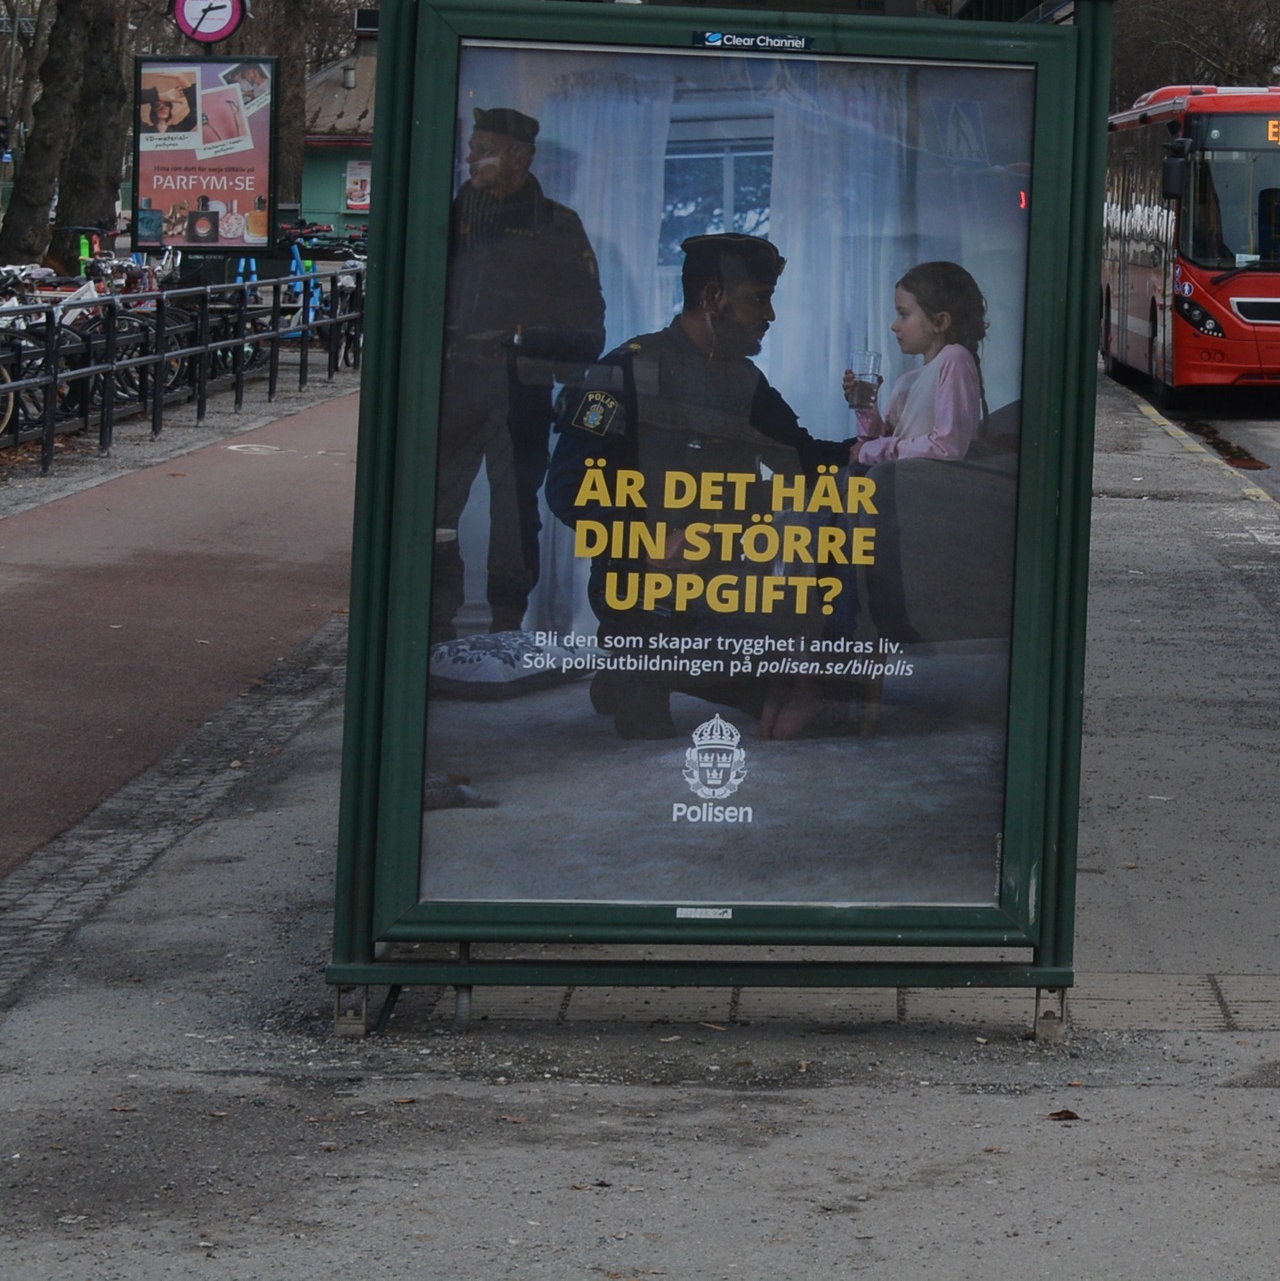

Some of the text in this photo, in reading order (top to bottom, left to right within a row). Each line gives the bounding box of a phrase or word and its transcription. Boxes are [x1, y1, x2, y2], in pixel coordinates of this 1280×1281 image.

[723, 34, 805, 48] Clear Channel
[588, 393, 615, 409] POLIS
[574, 458, 878, 514] ÄR DET HÄR
[574, 513, 876, 565] DIN STÖRRE
[605, 572, 843, 615] UPPGIFT?
[535, 631, 904, 655] Bli den som skapar trygghet i andras liv.
[522, 653, 914, 679] Sök polisutbildningen på polisen.se/blipolis
[672, 802, 753, 823] Polisen
